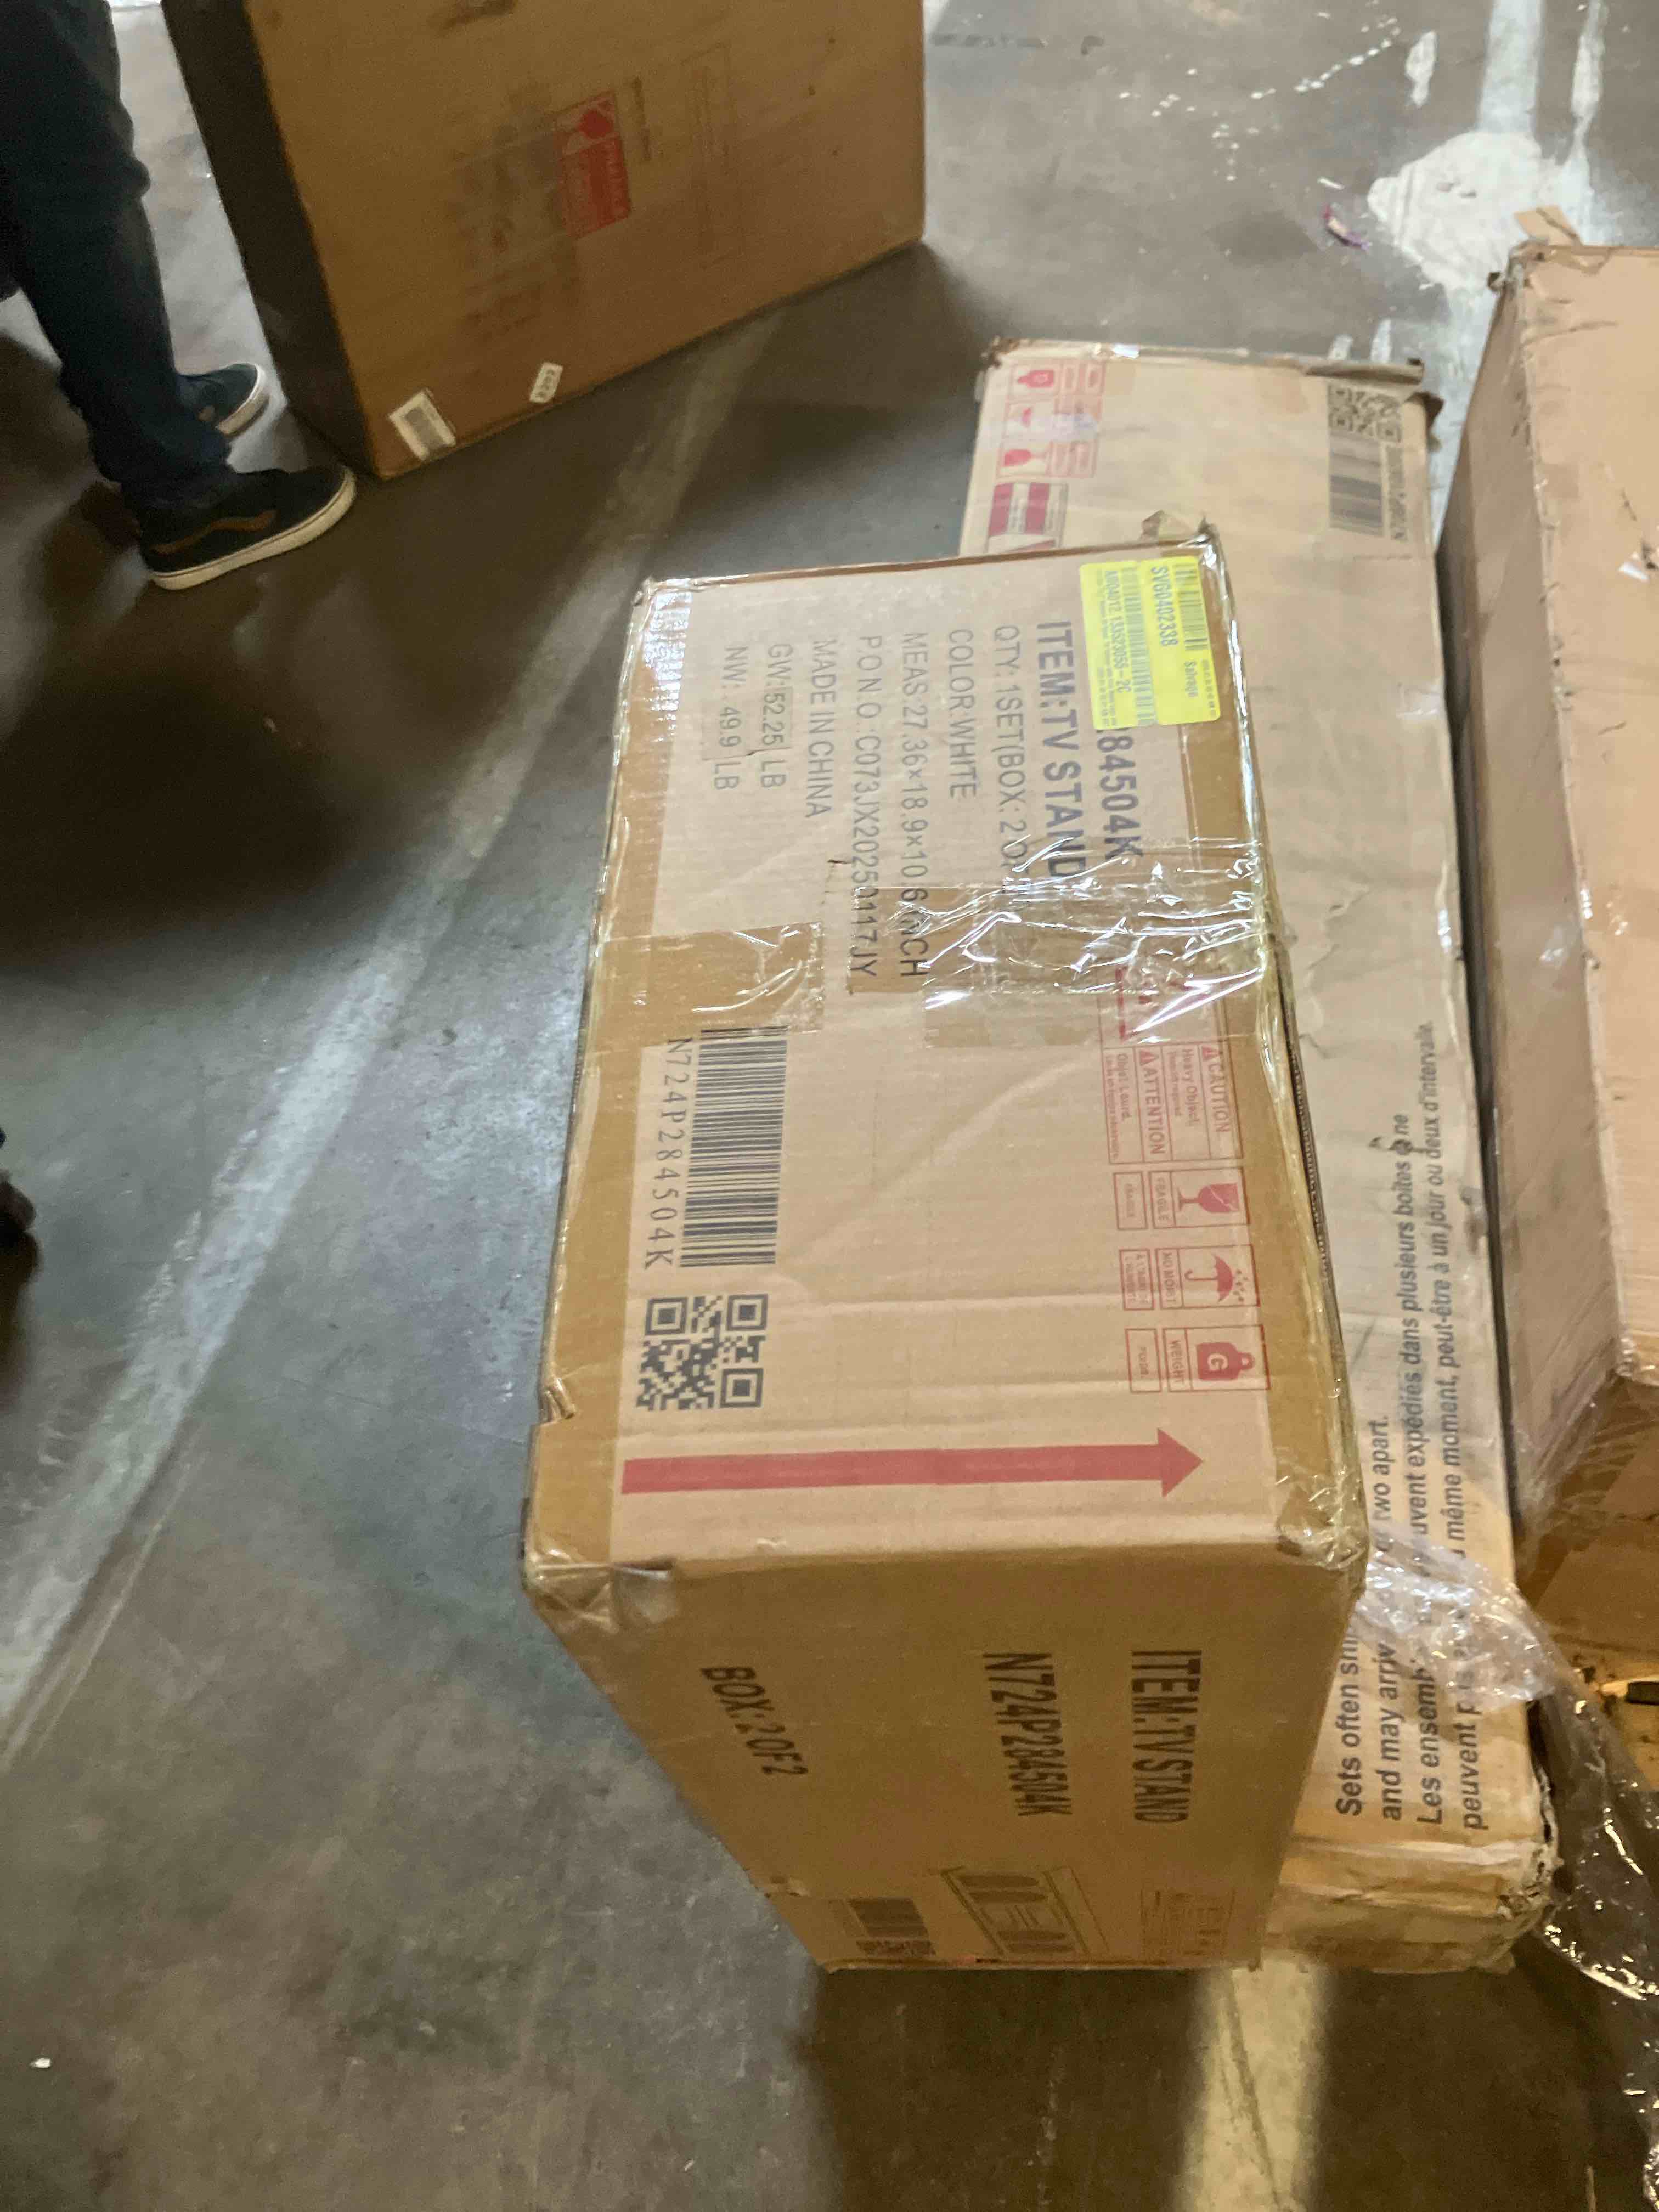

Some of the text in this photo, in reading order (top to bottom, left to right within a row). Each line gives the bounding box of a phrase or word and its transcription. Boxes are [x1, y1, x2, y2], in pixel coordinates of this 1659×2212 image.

[994, 625, 1020, 678] QTY:
[714, 646, 748, 790] NW: 49.9 LB
[805, 639, 837, 818] MADE IN CHINA
[760, 759, 787, 788] LB
[1096, 727, 1143, 860] 84504K
[1043, 760, 1086, 878] STAND
[1144, 1065, 1166, 1154] ATTENTION
[1208, 1062, 1231, 1132] CAUTION
[1392, 1114, 1409, 1136] ne
[645, 1037, 693, 1270] N724P284504K
[1419, 1117, 1442, 1158] deux
[1427, 1164, 1444, 1185] ou
[1424, 1190, 1452, 1227] jour
[1394, 1221, 1422, 1311] plusieurs
[1427, 1262, 1449, 1273] à
[1431, 1233, 1448, 1255] un
[1400, 1317, 1422, 1364] dans
[1431, 1280, 1460, 1368] peut-être
[1170, 1340, 1186, 1385] WEIGHT
[1368, 1414, 1395, 1475] apart.
[1396, 1372, 1430, 1466] expédiés
[1435, 1375, 1460, 1465] moment,
[1440, 1474, 1465, 1540] même
[1373, 1638, 1397, 1699] arriv
[985, 1652, 1073, 1816] N724P284504K
[1335, 1684, 1359, 1746] often
[1378, 1707, 1404, 1760] may
[1132, 1759, 1194, 1824] STAND
[1336, 1757, 1362, 1816] Sets
[1375, 1769, 1402, 1821] and
[1417, 1776, 1442, 1824] Les
[1454, 1722, 1488, 1830] peuvent
